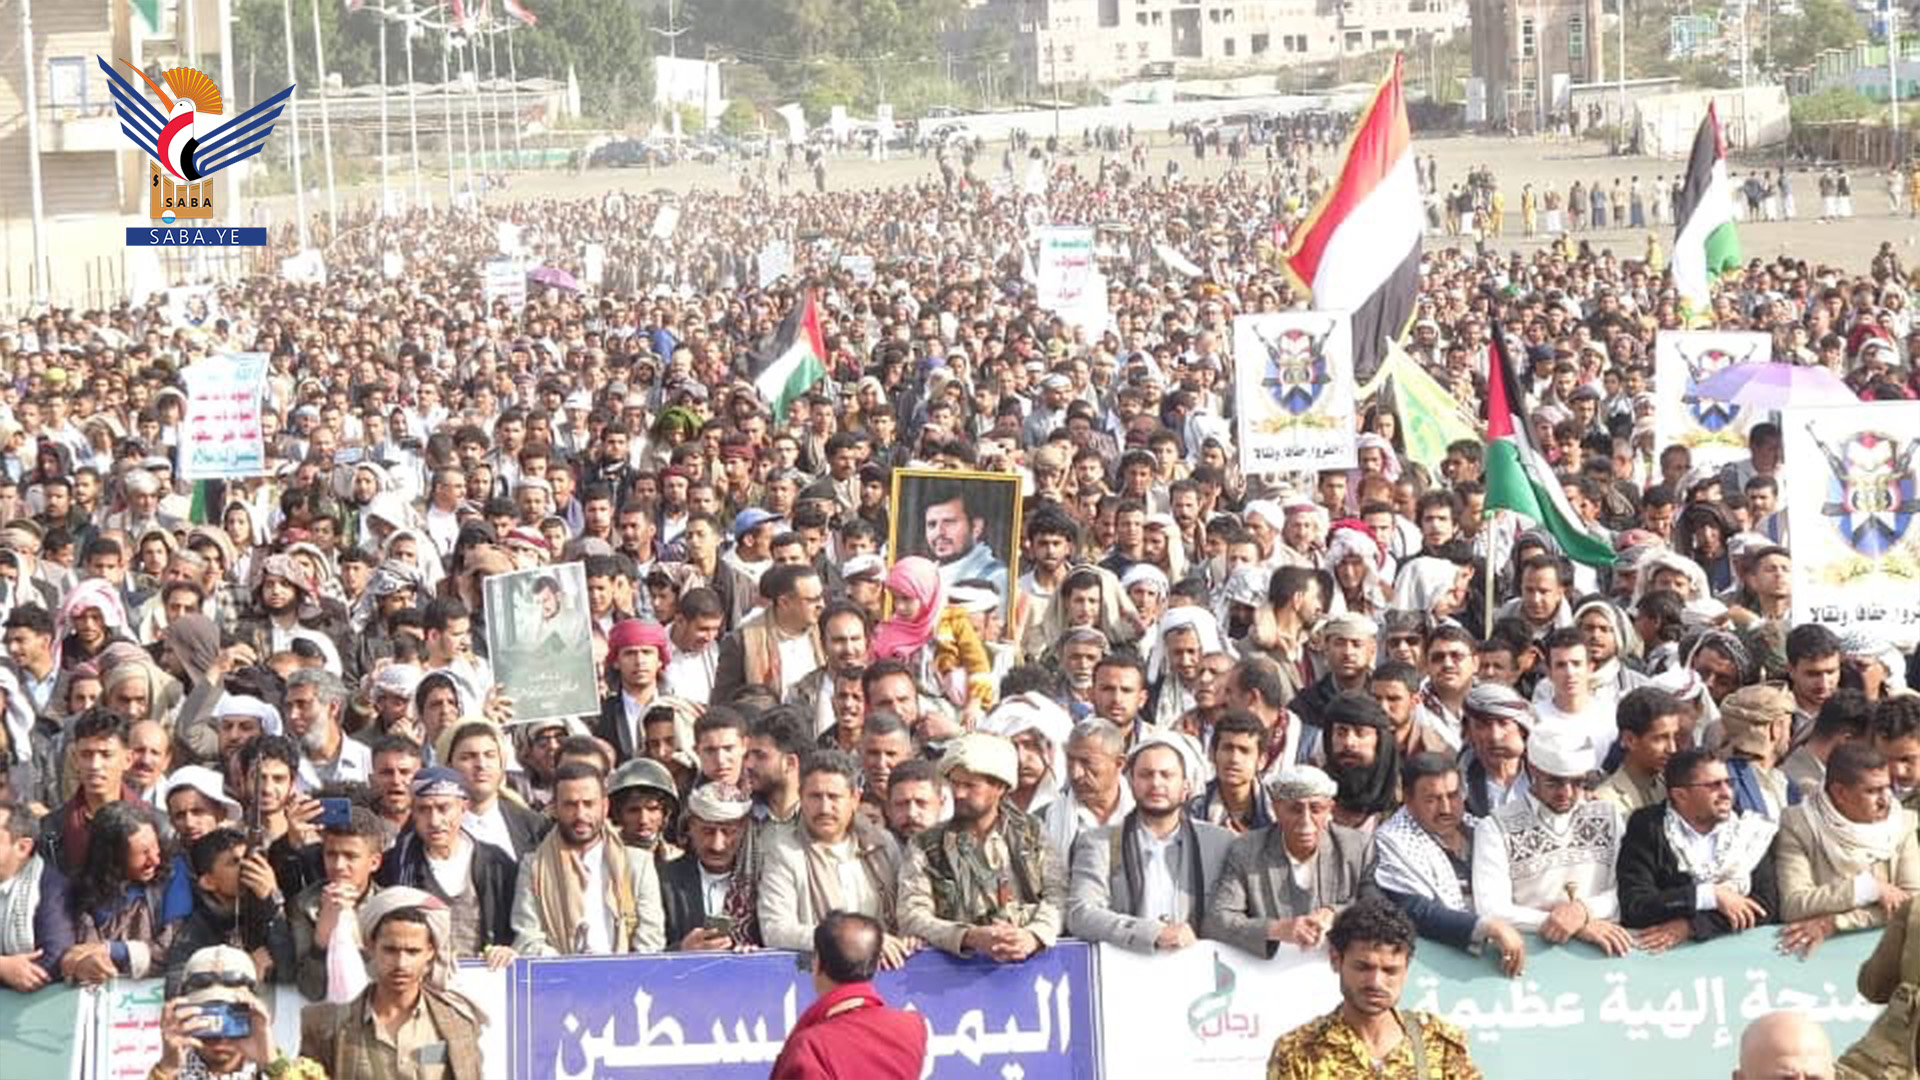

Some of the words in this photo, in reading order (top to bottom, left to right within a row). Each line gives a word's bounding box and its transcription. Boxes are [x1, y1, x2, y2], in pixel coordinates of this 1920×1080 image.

[1201, 1009, 1259, 1039] رجال
[1412, 975, 1585, 1042] عظيمة
[1600, 971, 1733, 1049] إلهية
[1740, 968, 1890, 1024] منحة
[555, 980, 798, 1080] لسطين
